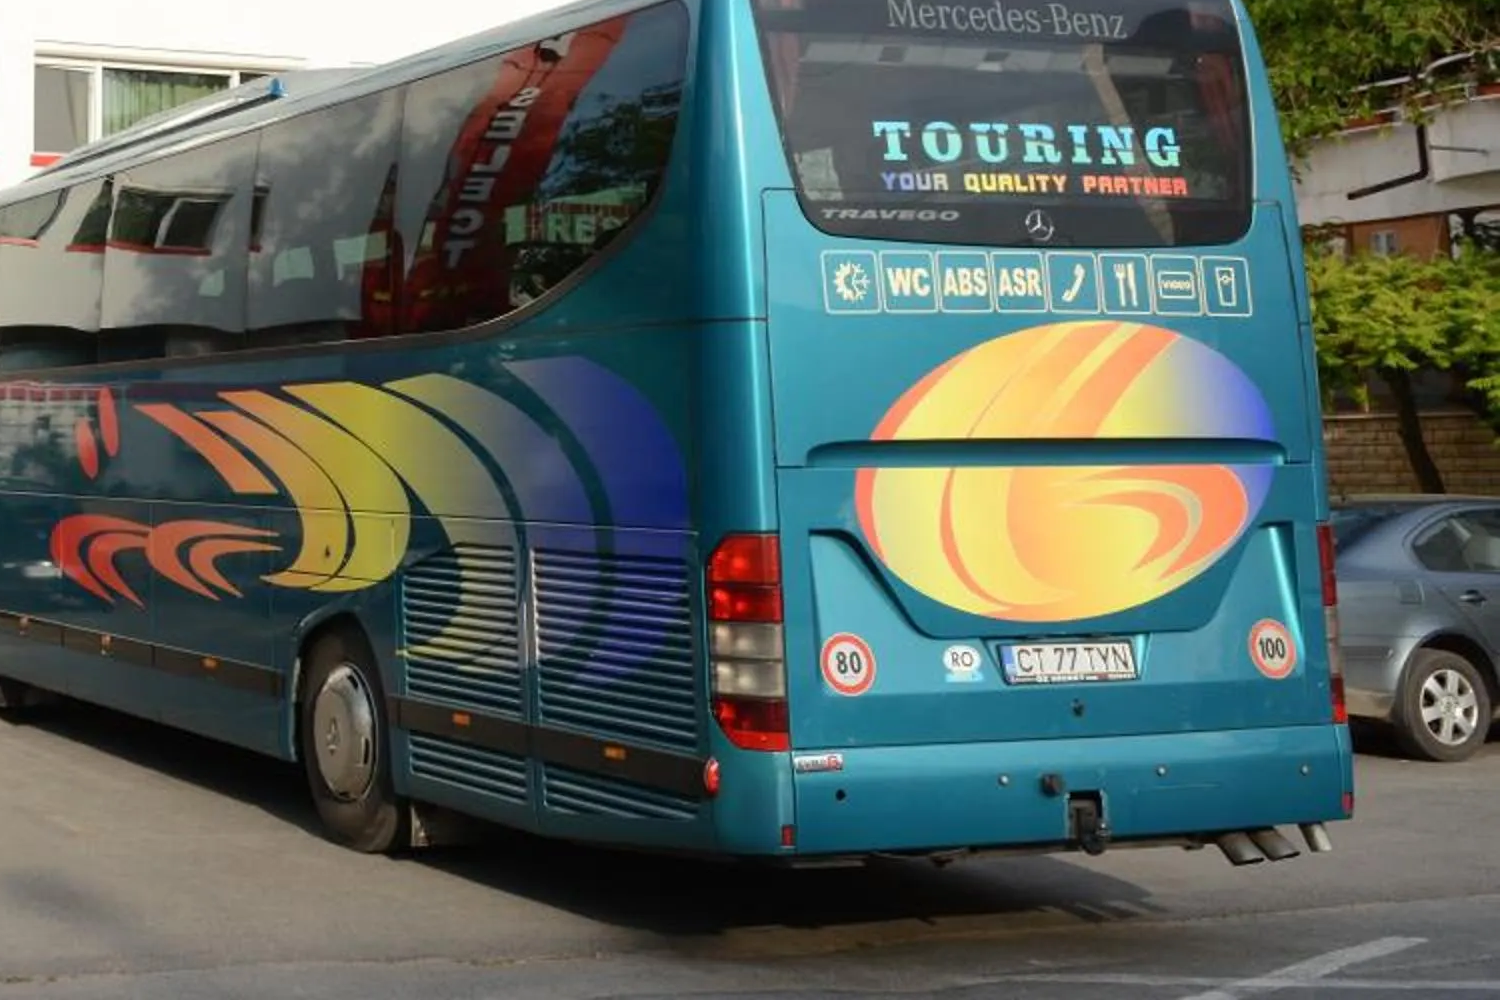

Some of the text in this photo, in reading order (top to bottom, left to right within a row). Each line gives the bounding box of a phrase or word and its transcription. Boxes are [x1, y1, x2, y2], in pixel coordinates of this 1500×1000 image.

[873, 121, 1181, 168] TOURING
[881, 171, 1188, 197] YOUR QUALITY PARTNER
[820, 208, 960, 223] TRAVEGO
[886, 266, 1043, 298] WC ABS ASR
[951, 651, 975, 668] RO
[1017, 645, 1130, 672] CT 77 TYN
[1258, 636, 1286, 660] 100
[835, 651, 862, 675] 80
